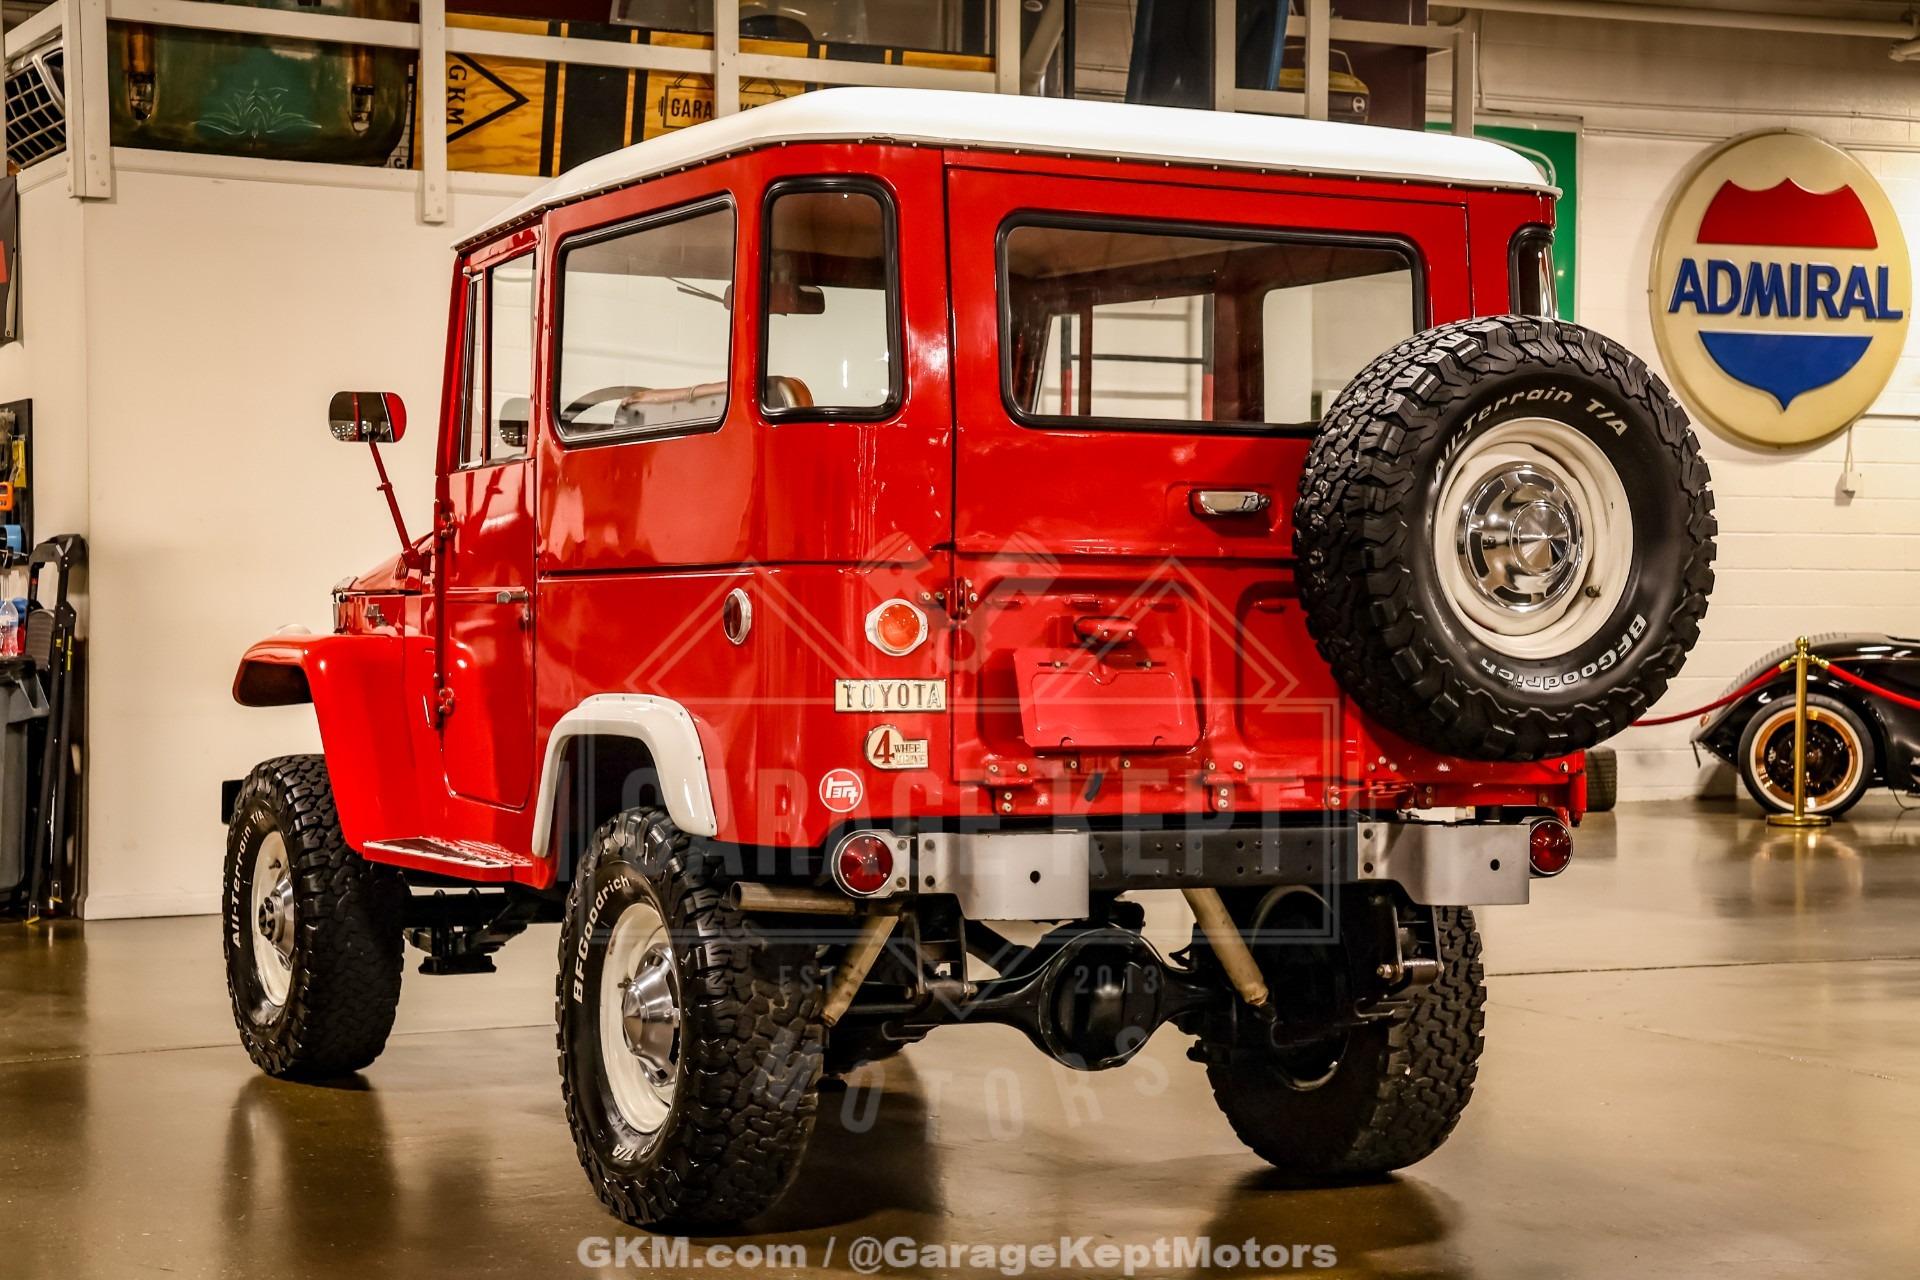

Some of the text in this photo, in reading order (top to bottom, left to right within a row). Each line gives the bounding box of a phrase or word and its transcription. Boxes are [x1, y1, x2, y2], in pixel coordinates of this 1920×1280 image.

[446, 65, 467, 126] GKM
[1668, 258, 1904, 320] ADMIRAL
[1433, 386, 1630, 486] All-Terrain T/A
[1479, 613, 1648, 691] BFGoodrich
[842, 682, 942, 709] TOYOTA
[872, 729, 895, 764] 4
[231, 808, 265, 949] All-Terrain T/A
[573, 873, 632, 1005] BFGoodrich
[611, 1143, 637, 1161] T/A
